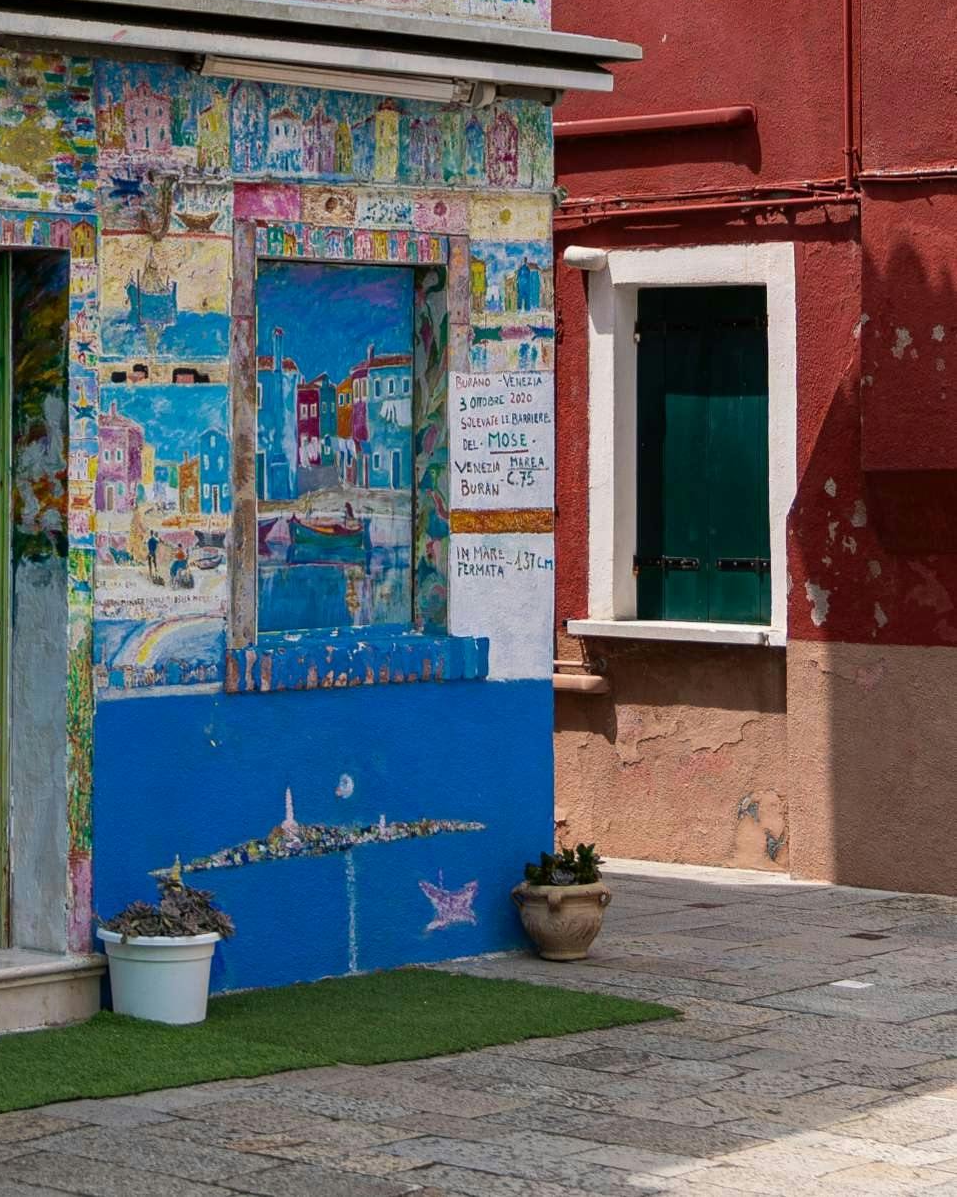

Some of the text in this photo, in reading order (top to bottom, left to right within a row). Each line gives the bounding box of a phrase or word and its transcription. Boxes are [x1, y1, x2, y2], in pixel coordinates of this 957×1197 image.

[456, 376, 491, 389] BURANO
[459, 392, 533, 411] 3 OTTOBRE 2020
[488, 431, 528, 448] MOSE
[455, 460, 501, 474] VENEZIA
[509, 456, 545, 468] MAREA
[461, 479, 499, 496] BURAN
[457, 546, 470, 561] IN
[457, 561, 504, 579] FERMATA
